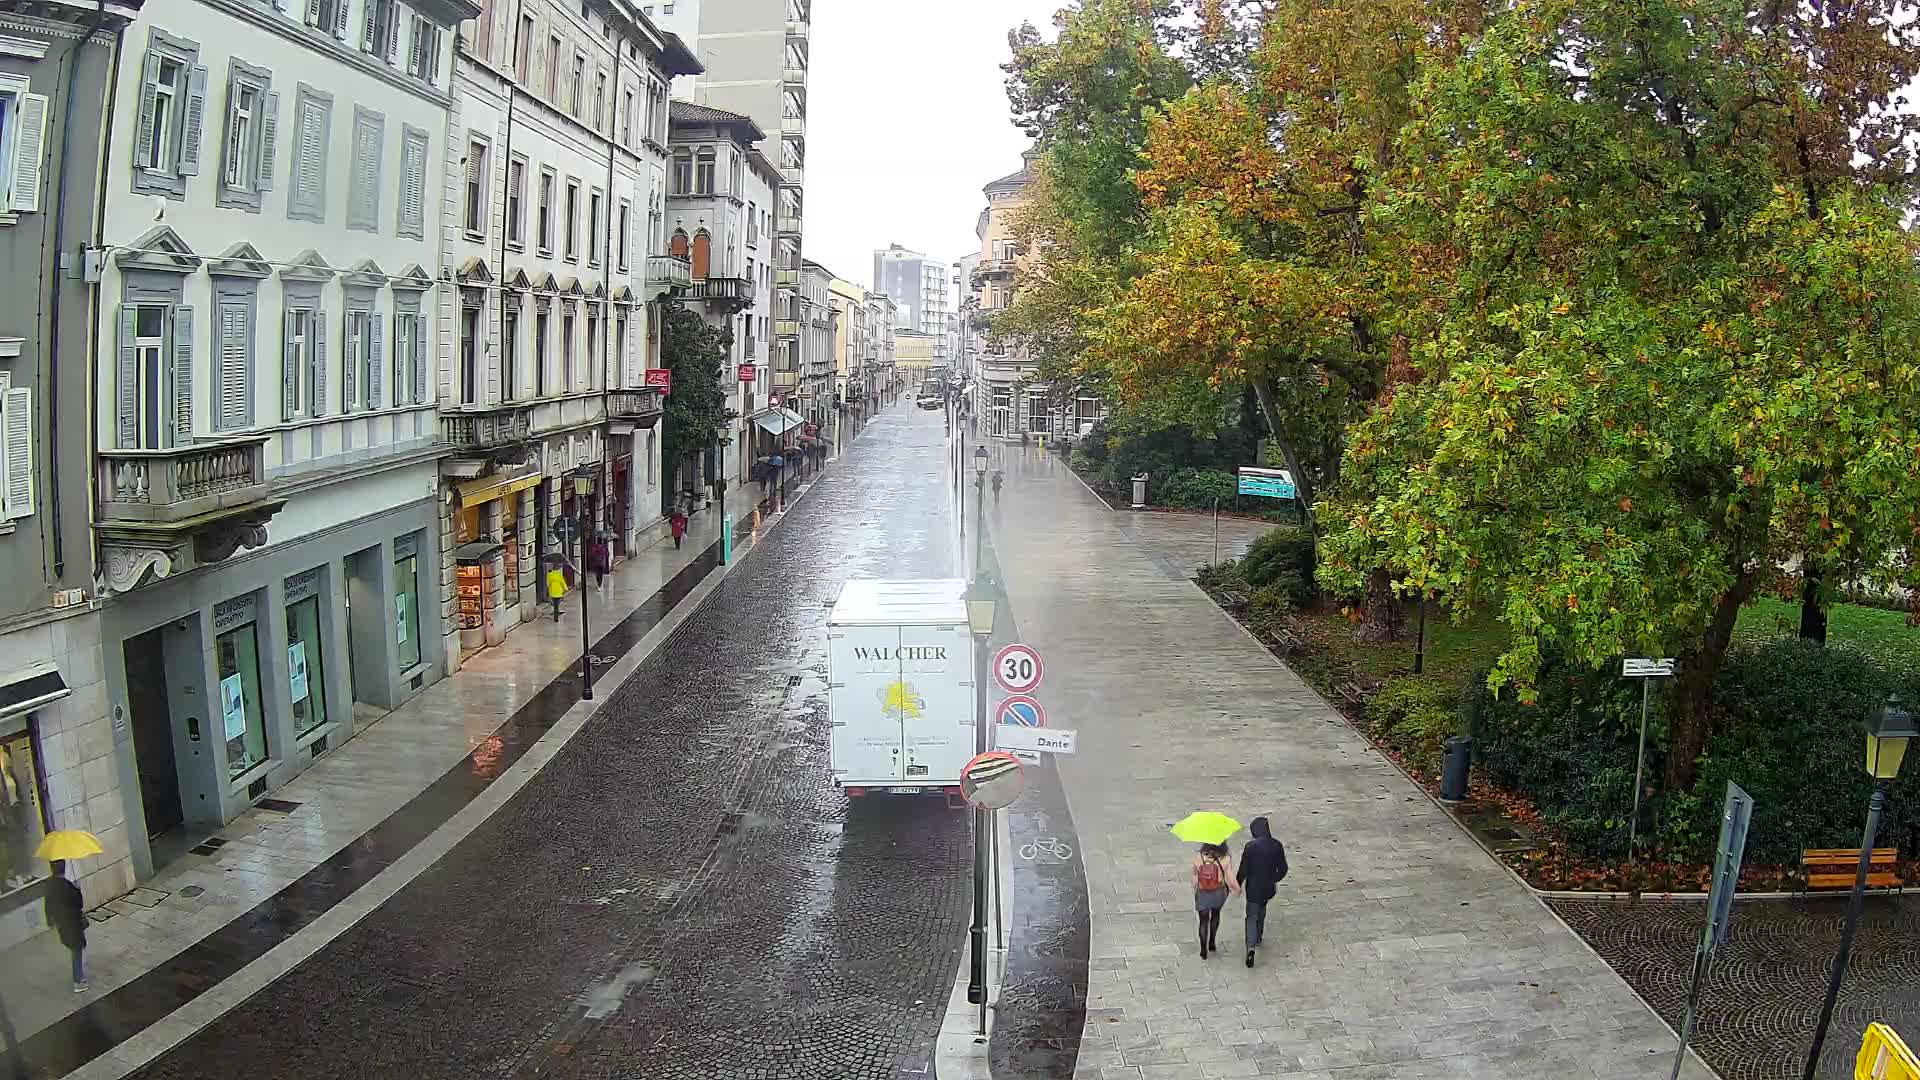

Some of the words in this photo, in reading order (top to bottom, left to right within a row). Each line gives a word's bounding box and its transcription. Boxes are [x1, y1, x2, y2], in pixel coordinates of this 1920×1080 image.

[854, 647, 947, 660] WALCHER
[1005, 658, 1032, 680] 30
[1037, 737, 1070, 749] Dante
